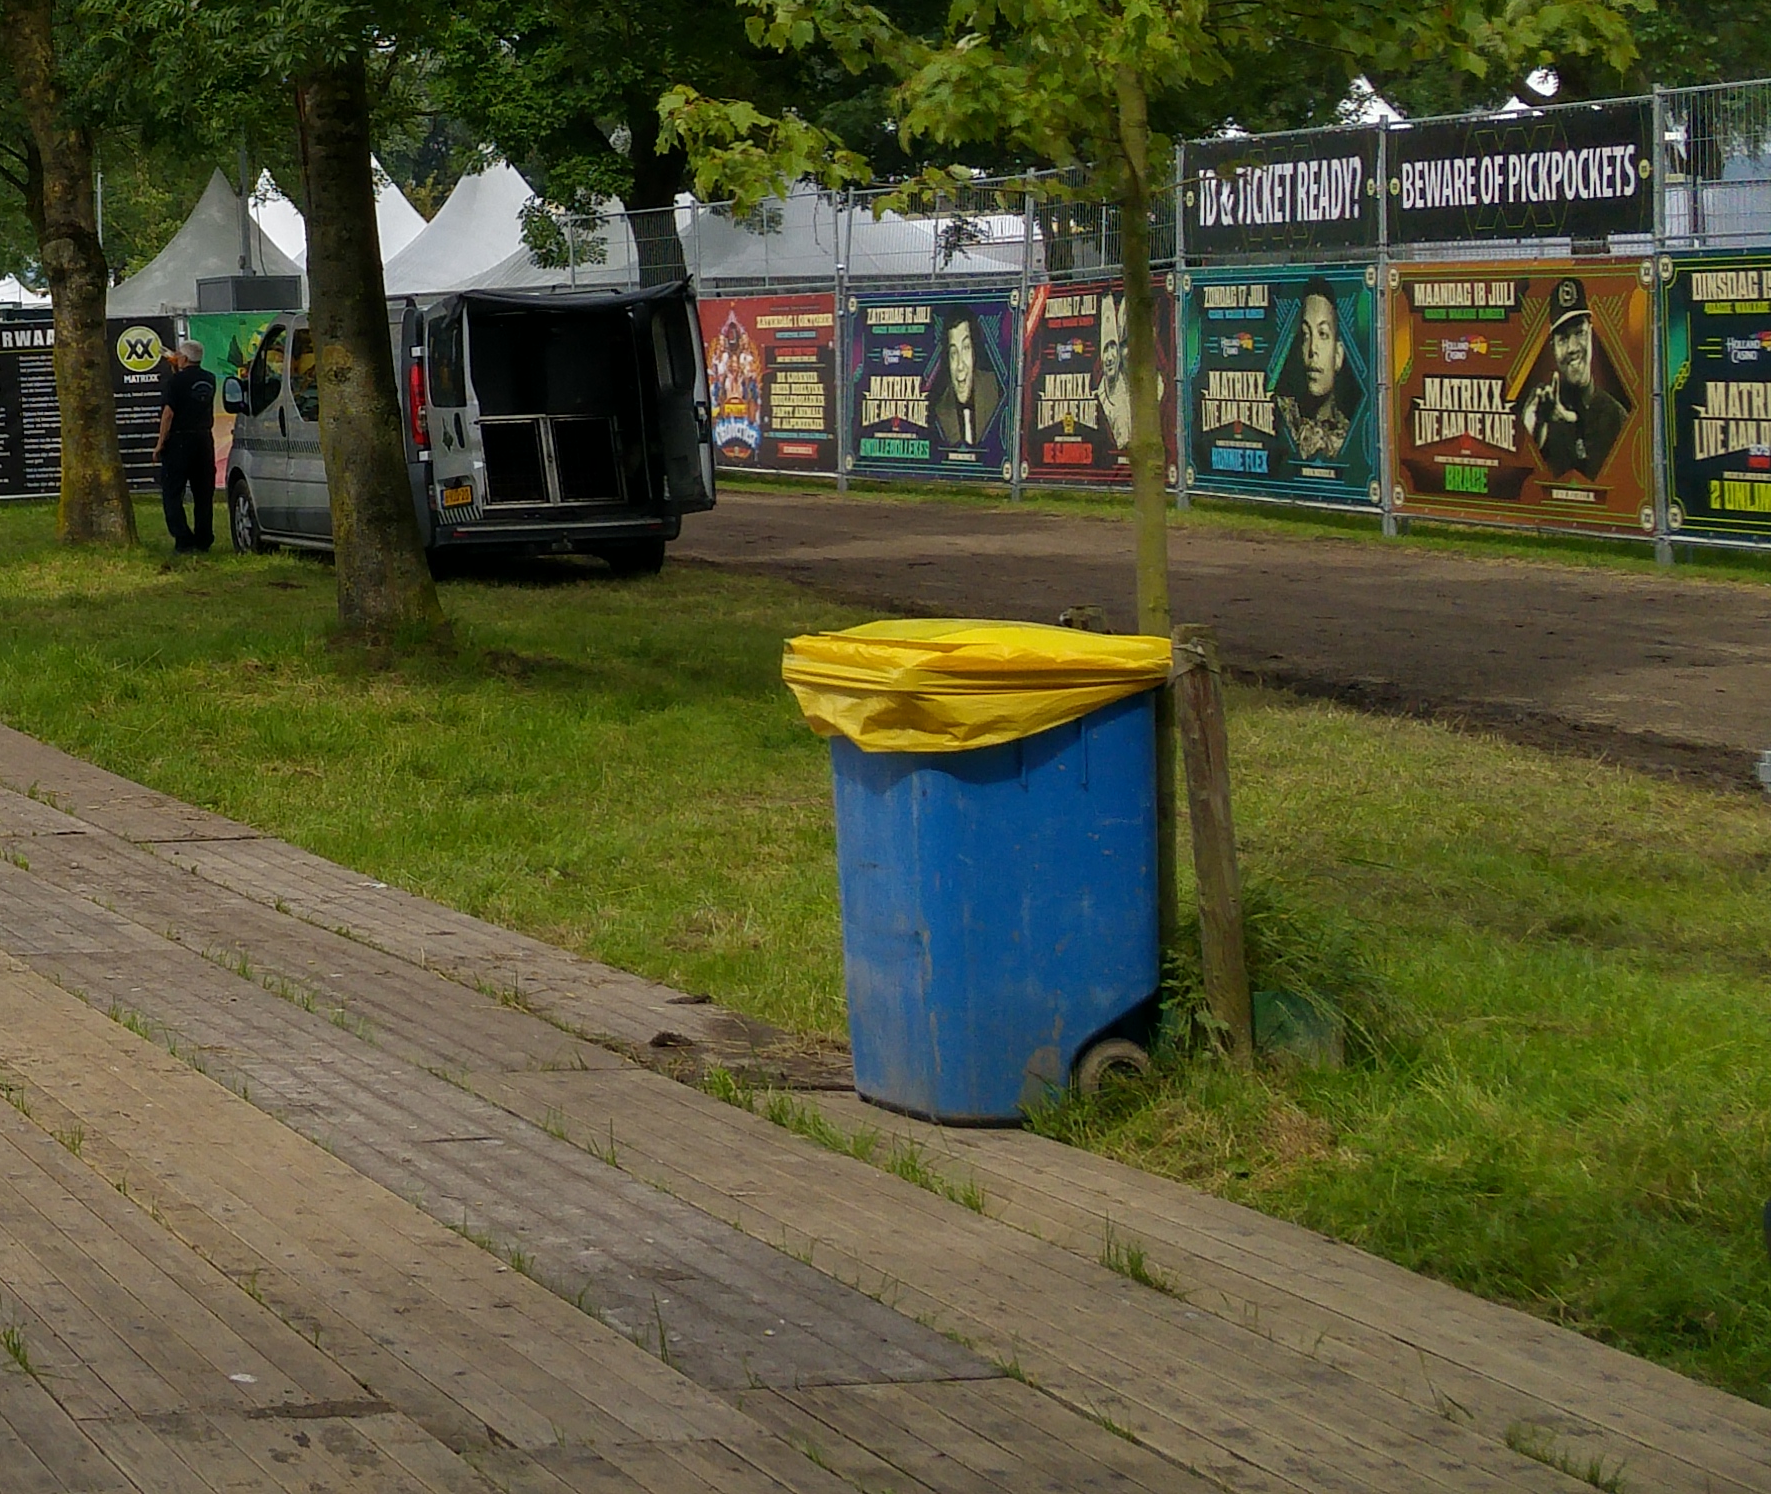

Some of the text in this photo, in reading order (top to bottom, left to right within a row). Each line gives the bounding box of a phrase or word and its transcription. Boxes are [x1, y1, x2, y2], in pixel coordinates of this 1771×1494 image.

[1198, 156, 1362, 226] ID & TICKET READY?
[1402, 145, 1636, 209] BEWARE OF PICKPOCKETS
[1203, 284, 1268, 308] ZONDAG 17 JULI
[1414, 282, 1515, 306] MAANDAG 18 JULI
[1692, 271, 1759, 301] DINSDAG
[870, 376, 922, 399] MATRIXX
[1045, 373, 1091, 399] MATRIXX
[1209, 371, 1265, 400] MATRIXX
[1424, 377, 1503, 412] MATRIXX
[862, 400, 879, 426] LIVE
[1201, 399, 1219, 432] LIVE
[1252, 402, 1276, 436] KADE
[1414, 410, 1517, 453] LIVE AAN DE KADE
[1693, 419, 1726, 461] LIVE
[1728, 419, 1757, 452] AAN
[1246, 449, 1269, 474] FLEX
[1445, 464, 1489, 493] BRACE
[1709, 479, 1720, 509] 2
